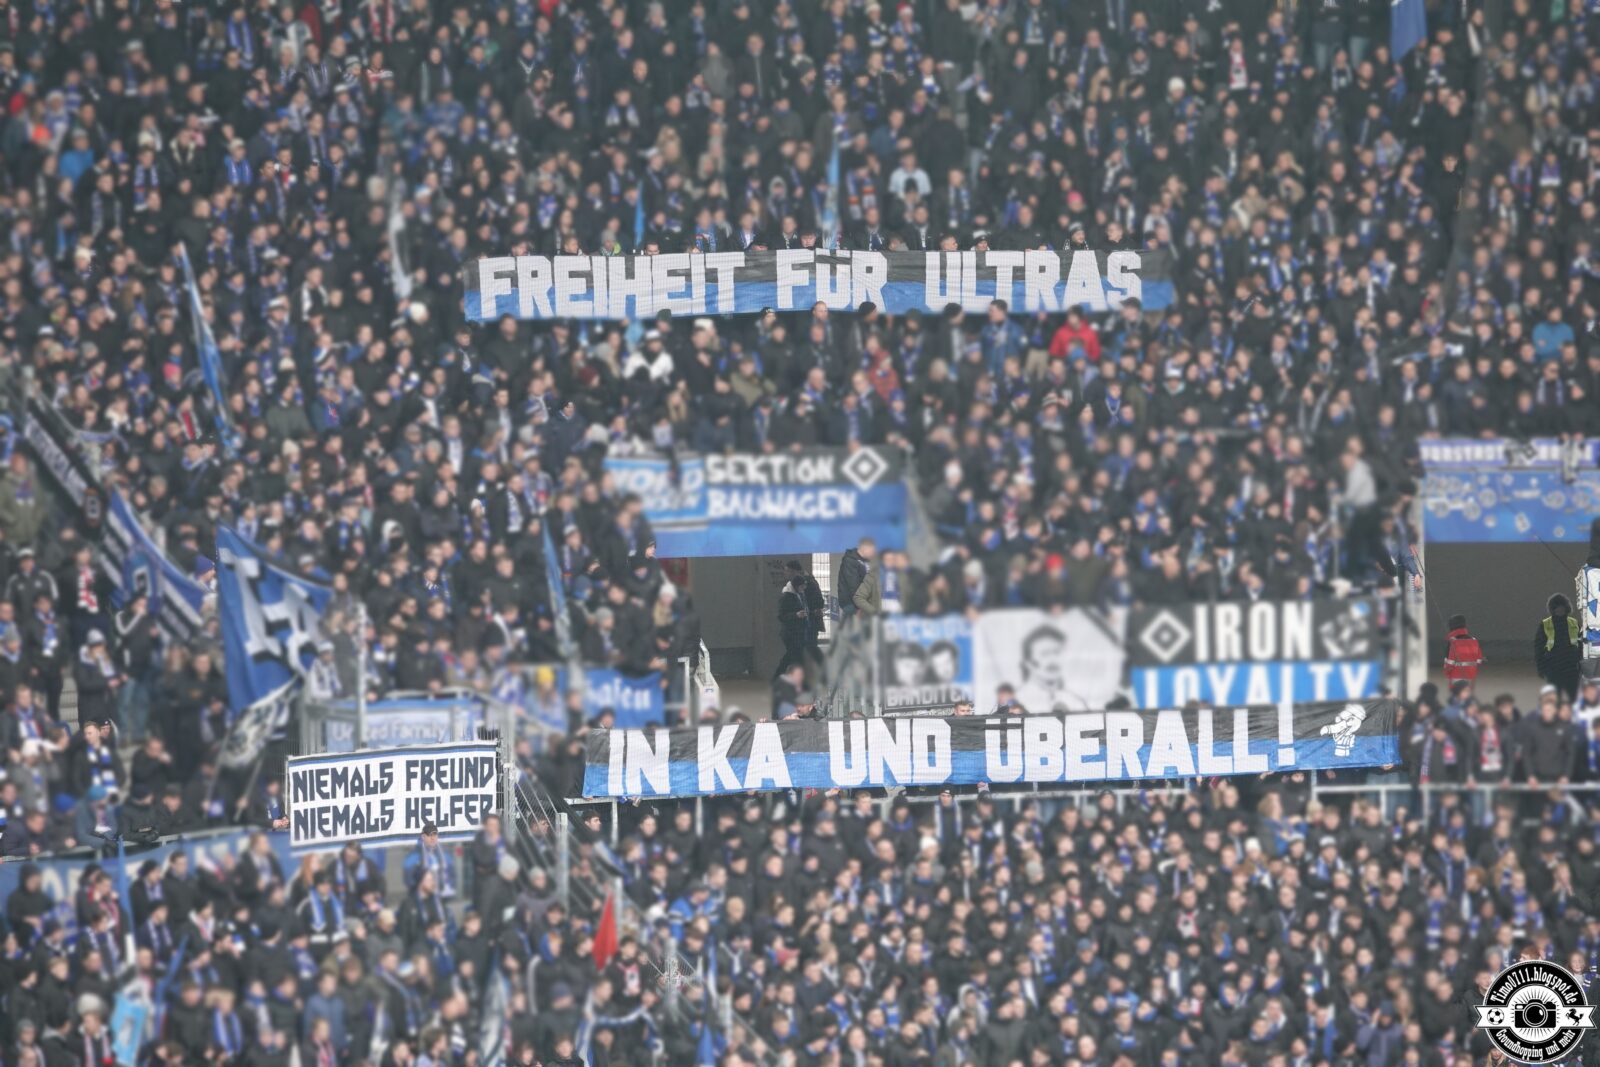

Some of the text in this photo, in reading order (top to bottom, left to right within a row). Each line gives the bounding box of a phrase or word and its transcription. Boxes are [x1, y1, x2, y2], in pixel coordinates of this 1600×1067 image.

[479, 247, 1142, 319] FREIHEIT FÜR ULTRAS
[707, 489, 856, 520] BAUWAGEN
[1194, 601, 1313, 663] IRON
[292, 756, 494, 803] NIEMALS FREUND
[608, 729, 671, 797] IN
[697, 722, 793, 792] KA
[828, 718, 952, 787] UND
[293, 798, 395, 841] NIEMALS
